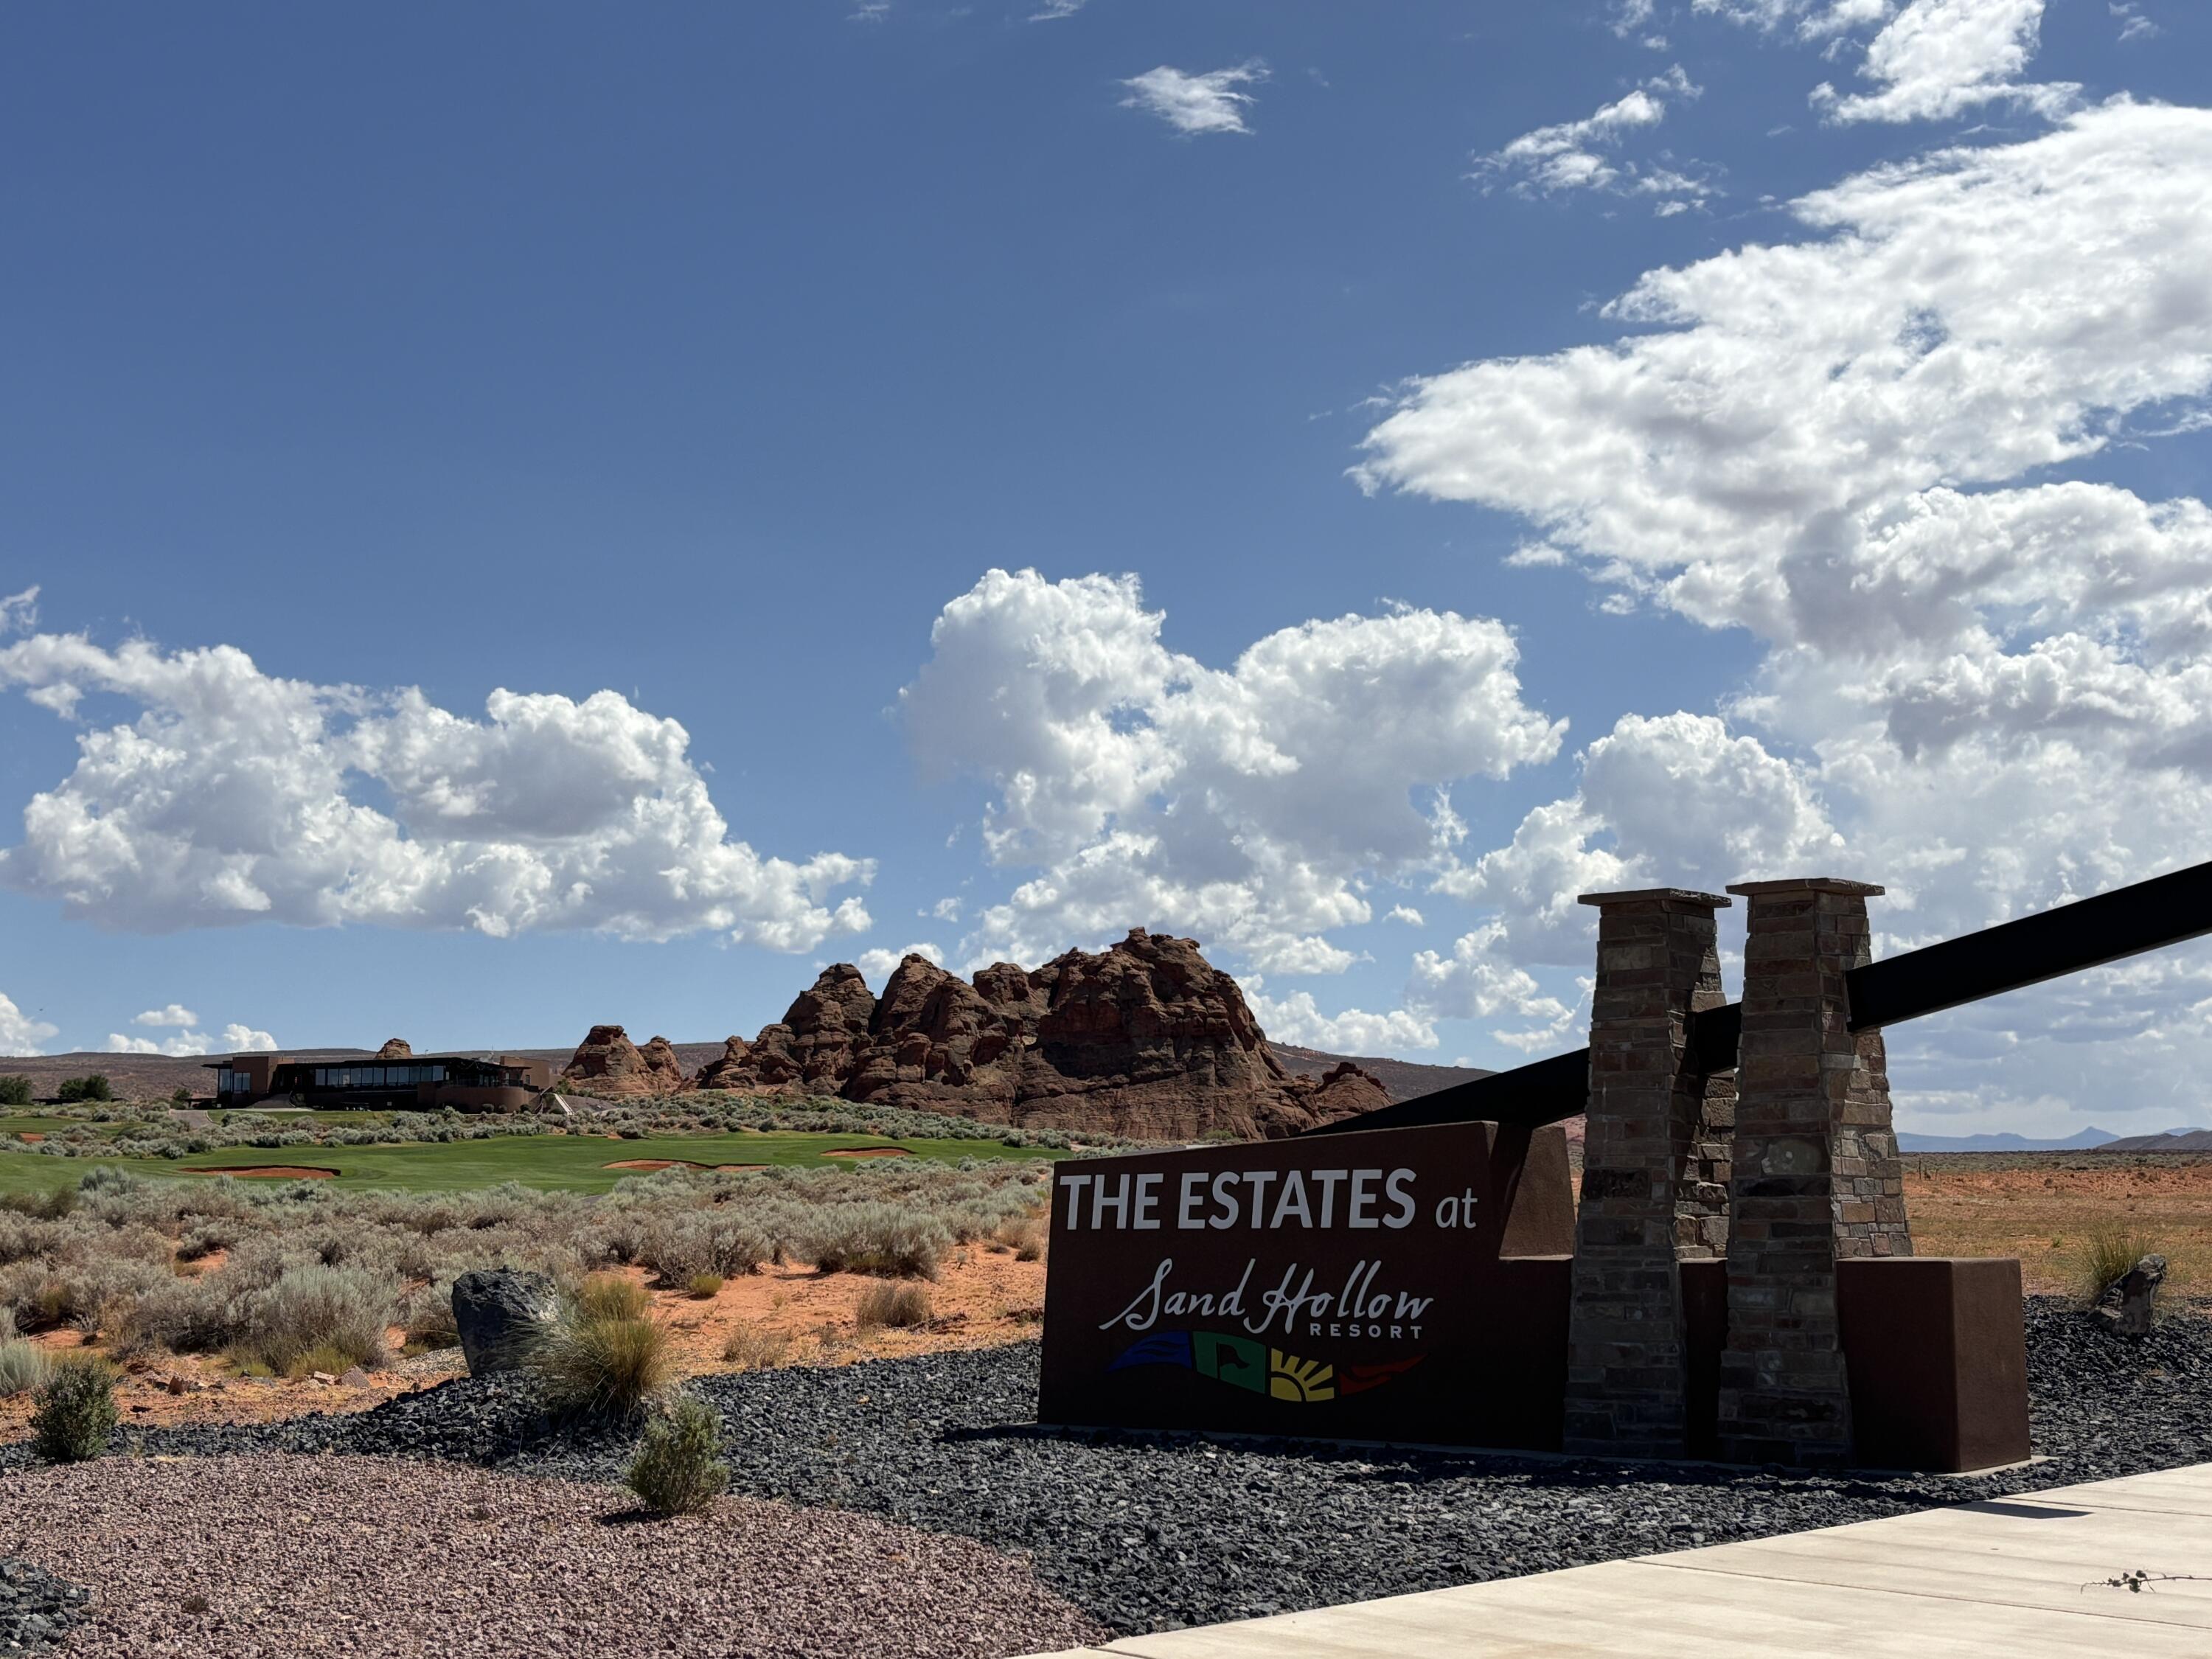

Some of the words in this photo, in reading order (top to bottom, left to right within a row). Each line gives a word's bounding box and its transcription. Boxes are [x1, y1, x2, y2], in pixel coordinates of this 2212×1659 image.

[1060, 1173, 1164, 1230] THE
[1178, 1168, 1417, 1230] ESTATES
[1436, 1188, 1478, 1228] at
[1099, 1258, 1256, 1330] Sand
[1243, 1259, 1434, 1334] Hollow
[1310, 1323, 1422, 1339] RESORT
